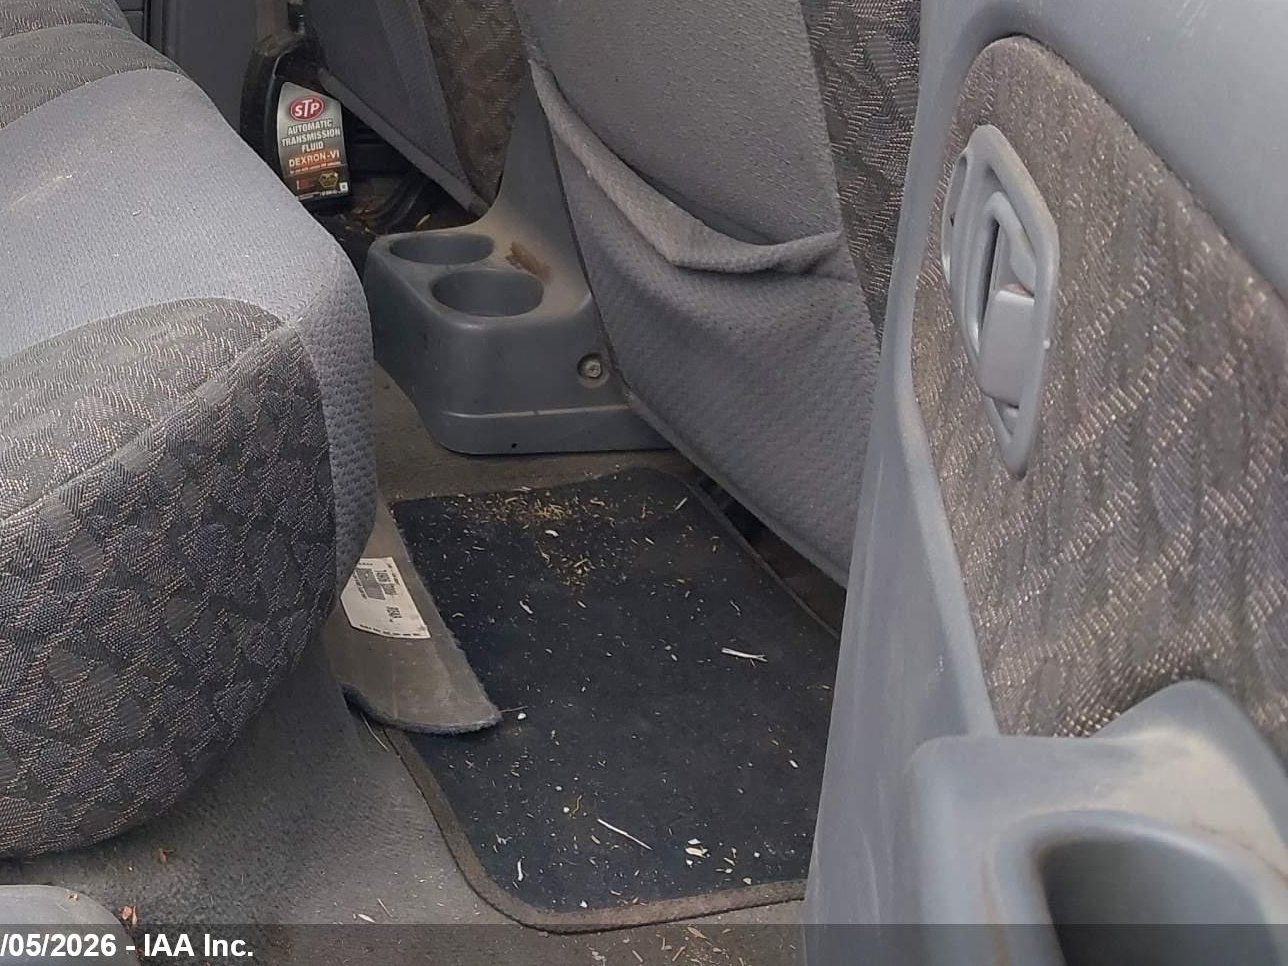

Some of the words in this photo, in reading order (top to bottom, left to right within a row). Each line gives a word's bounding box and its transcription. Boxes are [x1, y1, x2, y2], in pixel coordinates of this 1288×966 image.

[294, 99, 320, 117] STP
[287, 118, 333, 136] AUTOMATIC
[281, 128, 341, 147] TRANSMISSION
[301, 142, 324, 153] FLUID
